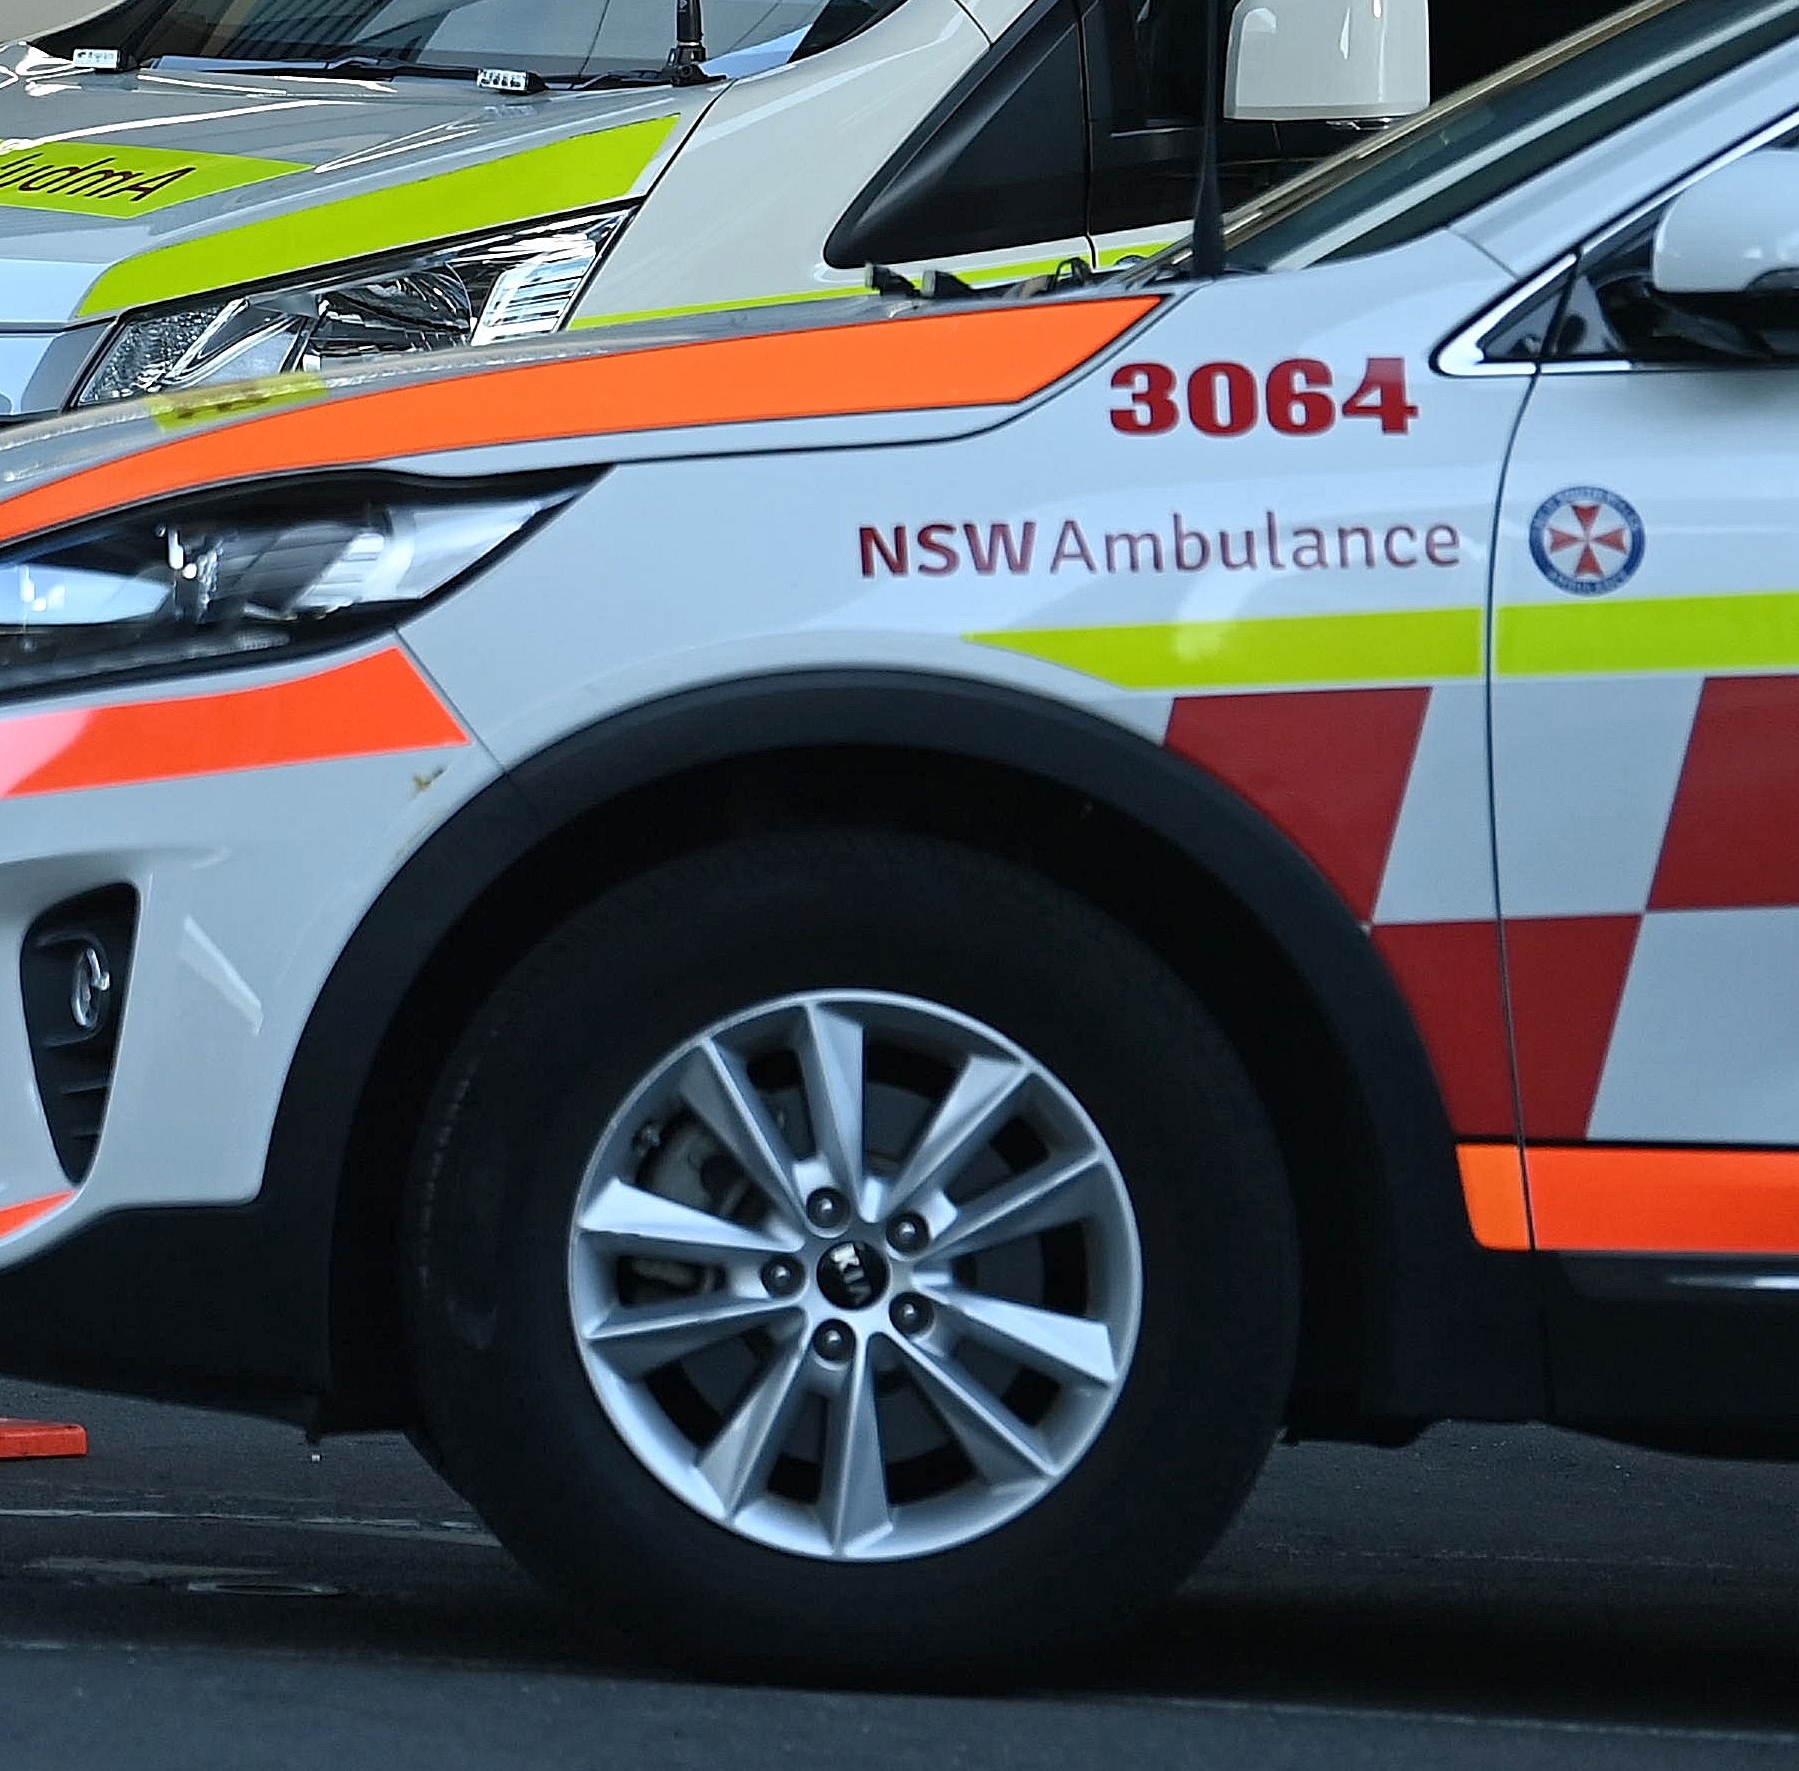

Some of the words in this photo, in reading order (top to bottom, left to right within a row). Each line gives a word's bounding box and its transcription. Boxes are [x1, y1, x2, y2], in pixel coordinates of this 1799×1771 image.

[1108, 356, 1421, 438] 3064
[858, 519, 1038, 579] NSW
[1049, 509, 1463, 576] Ambulance
